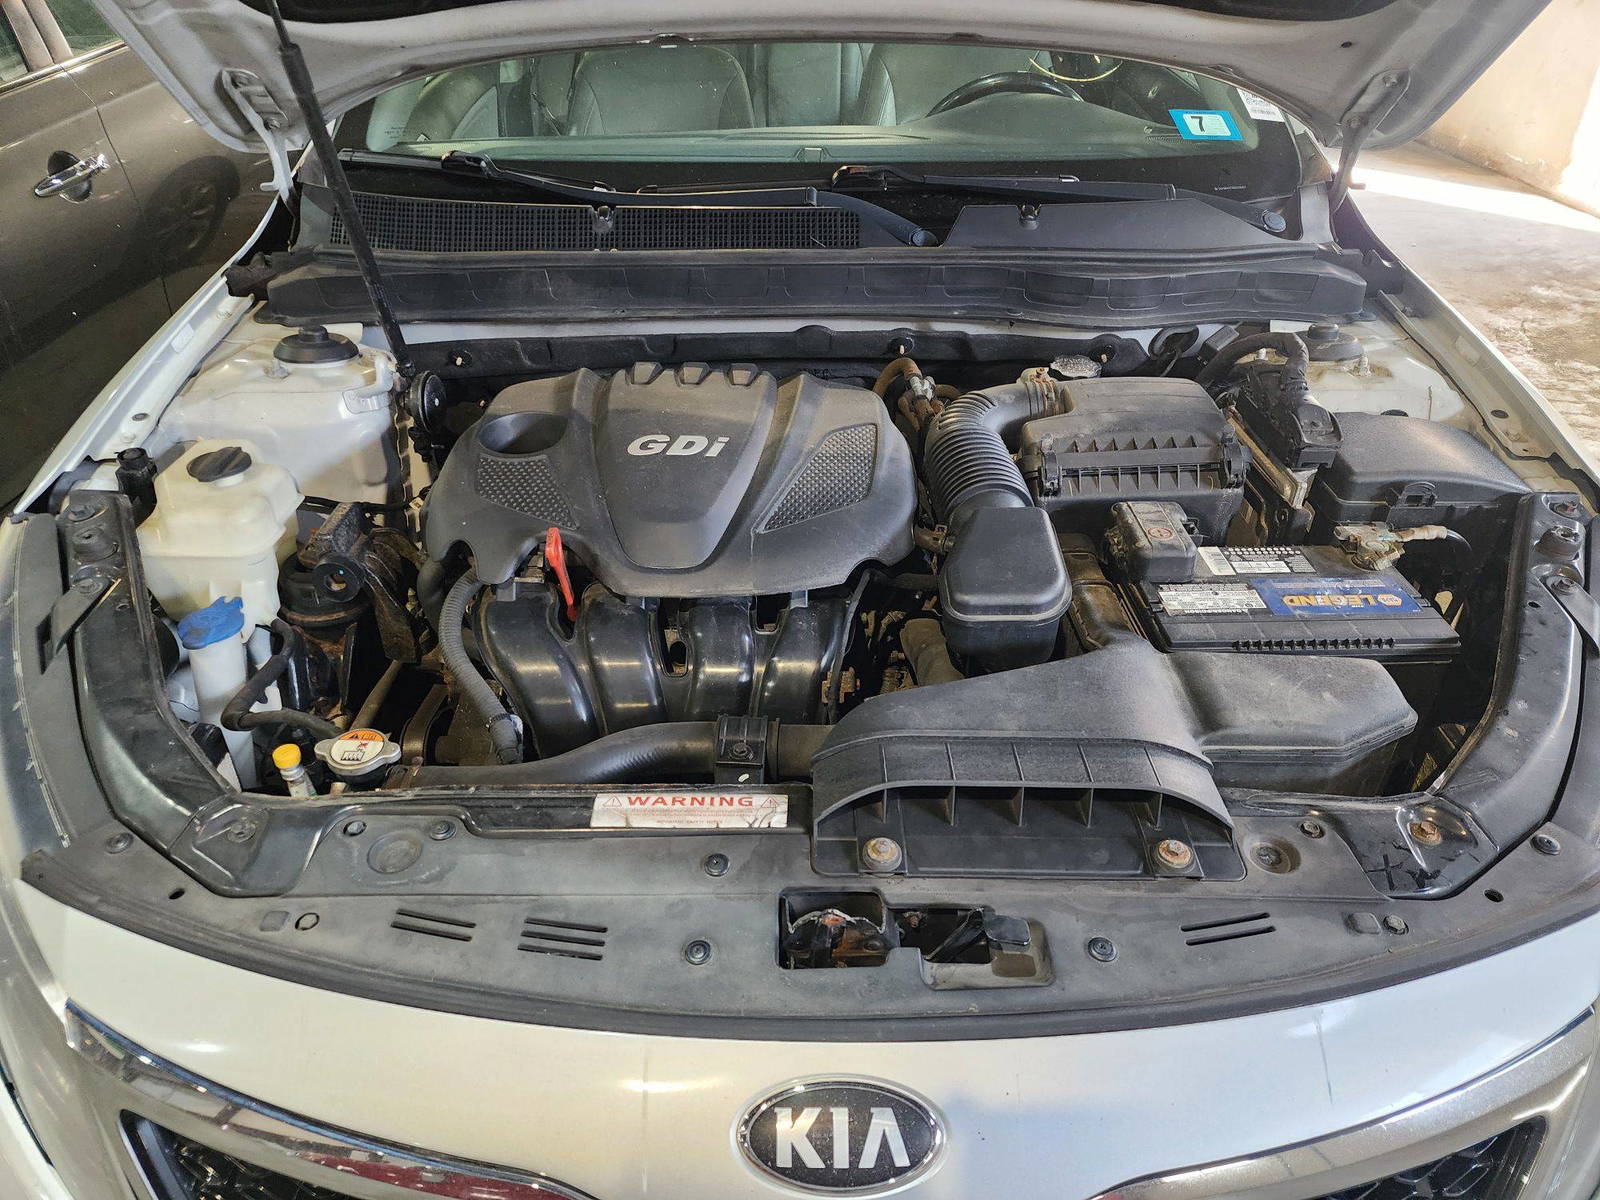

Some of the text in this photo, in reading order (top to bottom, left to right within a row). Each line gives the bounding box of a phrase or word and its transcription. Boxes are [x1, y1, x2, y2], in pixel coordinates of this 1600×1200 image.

[1190, 115, 1206, 133] 7
[627, 434, 730, 457] GDi
[1282, 594, 1377, 606] LEGEND
[627, 796, 753, 807] WARNING
[774, 1106, 911, 1169] KIA
